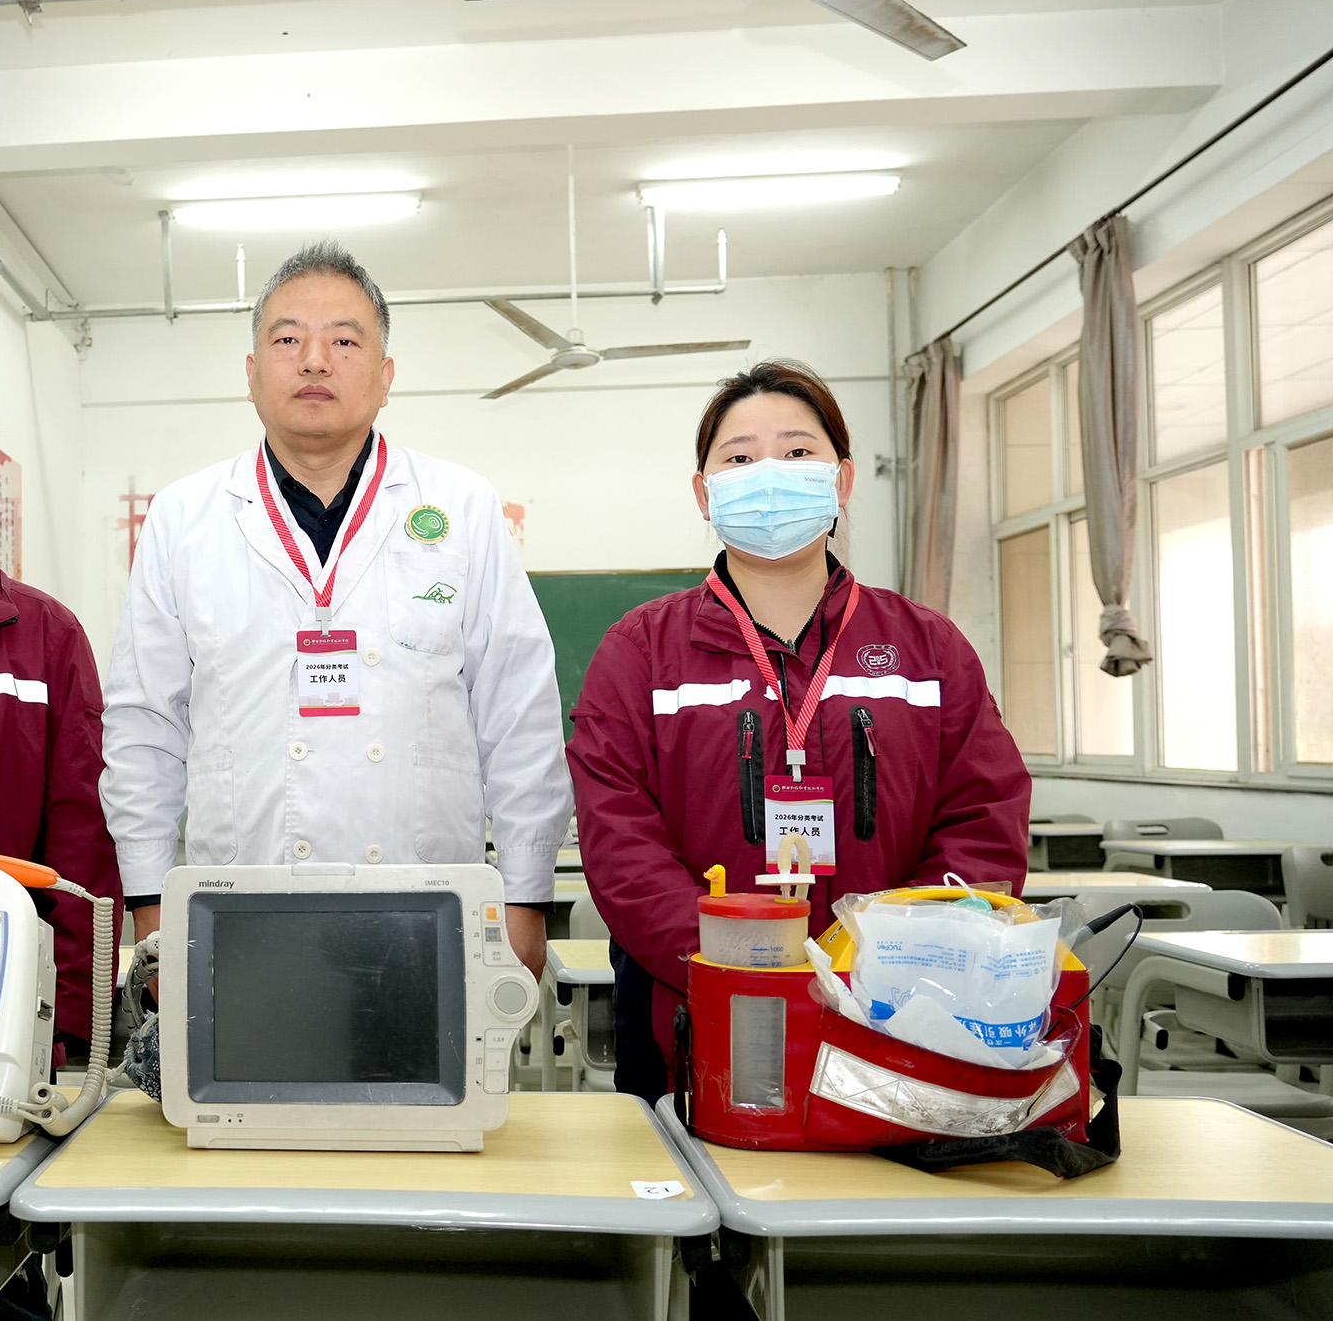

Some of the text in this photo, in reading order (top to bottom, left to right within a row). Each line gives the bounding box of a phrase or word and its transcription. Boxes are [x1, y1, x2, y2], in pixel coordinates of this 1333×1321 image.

[310, 674, 346, 683] 工作人员
[198, 879, 235, 889] mindray
